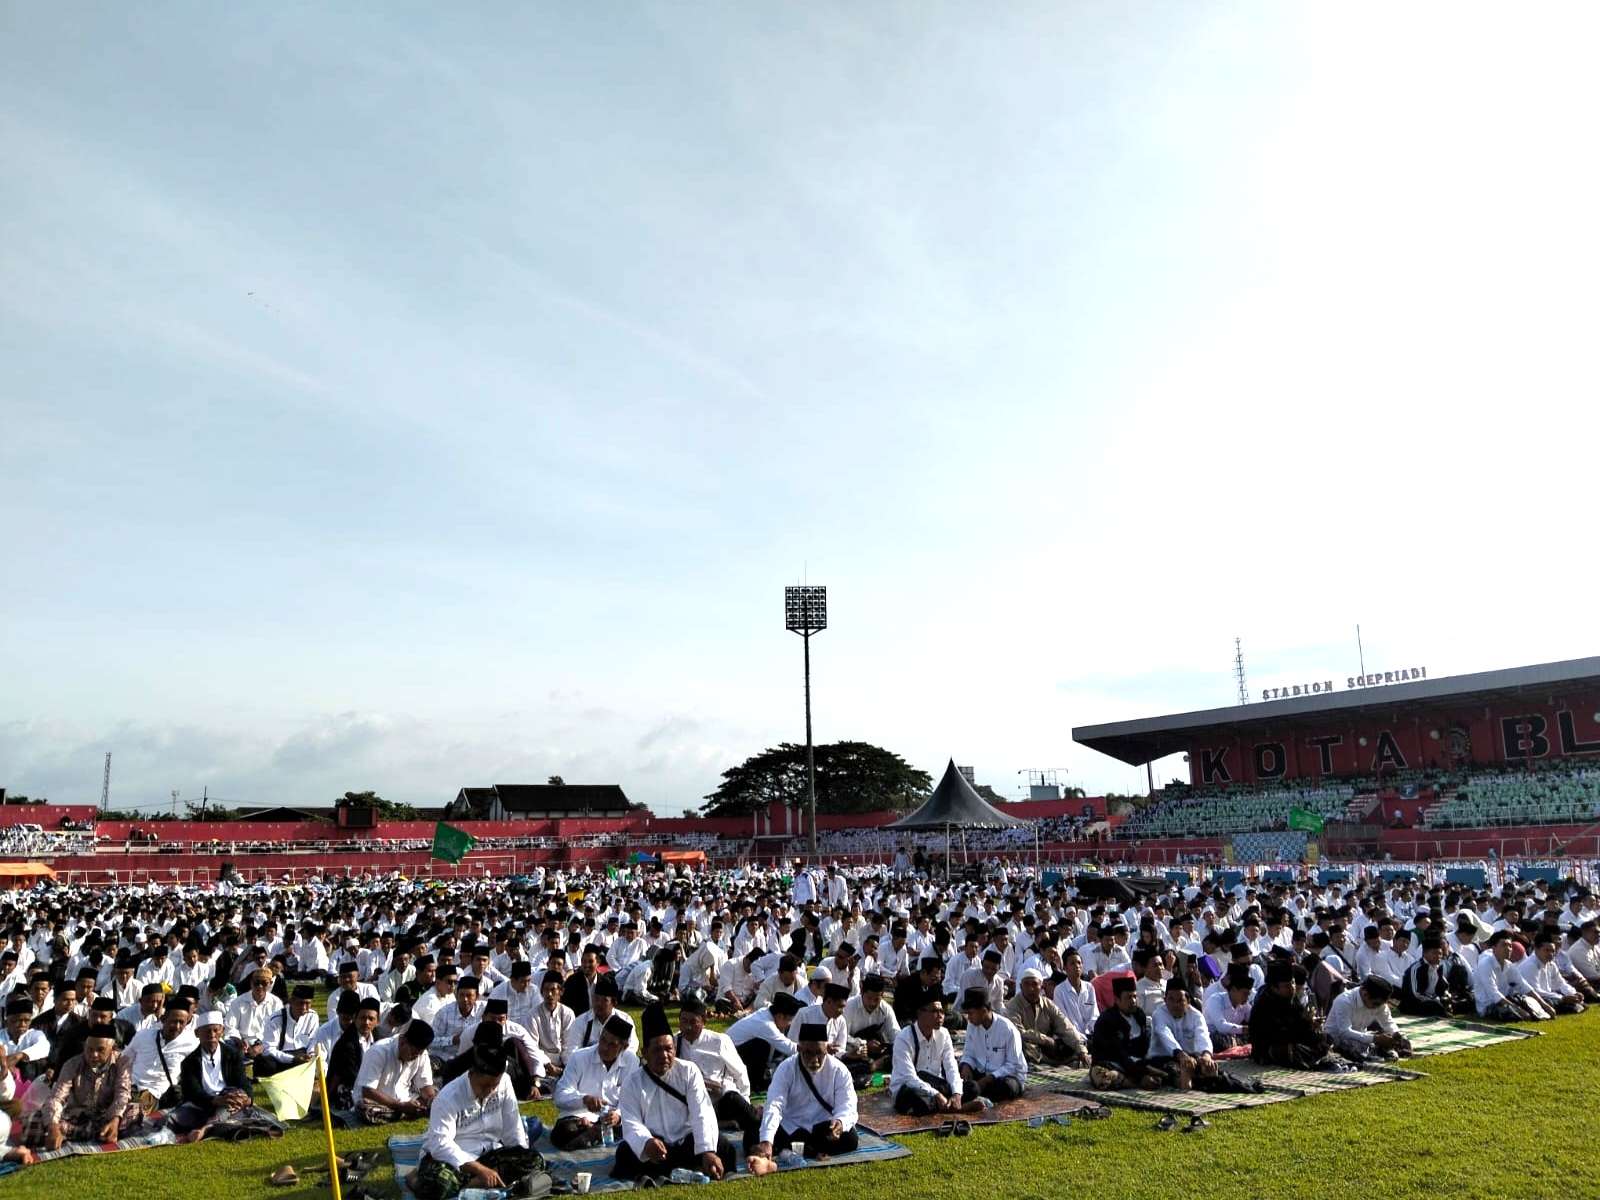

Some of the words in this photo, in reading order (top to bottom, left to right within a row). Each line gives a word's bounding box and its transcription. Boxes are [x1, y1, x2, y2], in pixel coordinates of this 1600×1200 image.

[1262, 681, 1333, 700] STADION
[1347, 666, 1427, 688] SOEPRIADI
[1200, 730, 1408, 784] KOTA
